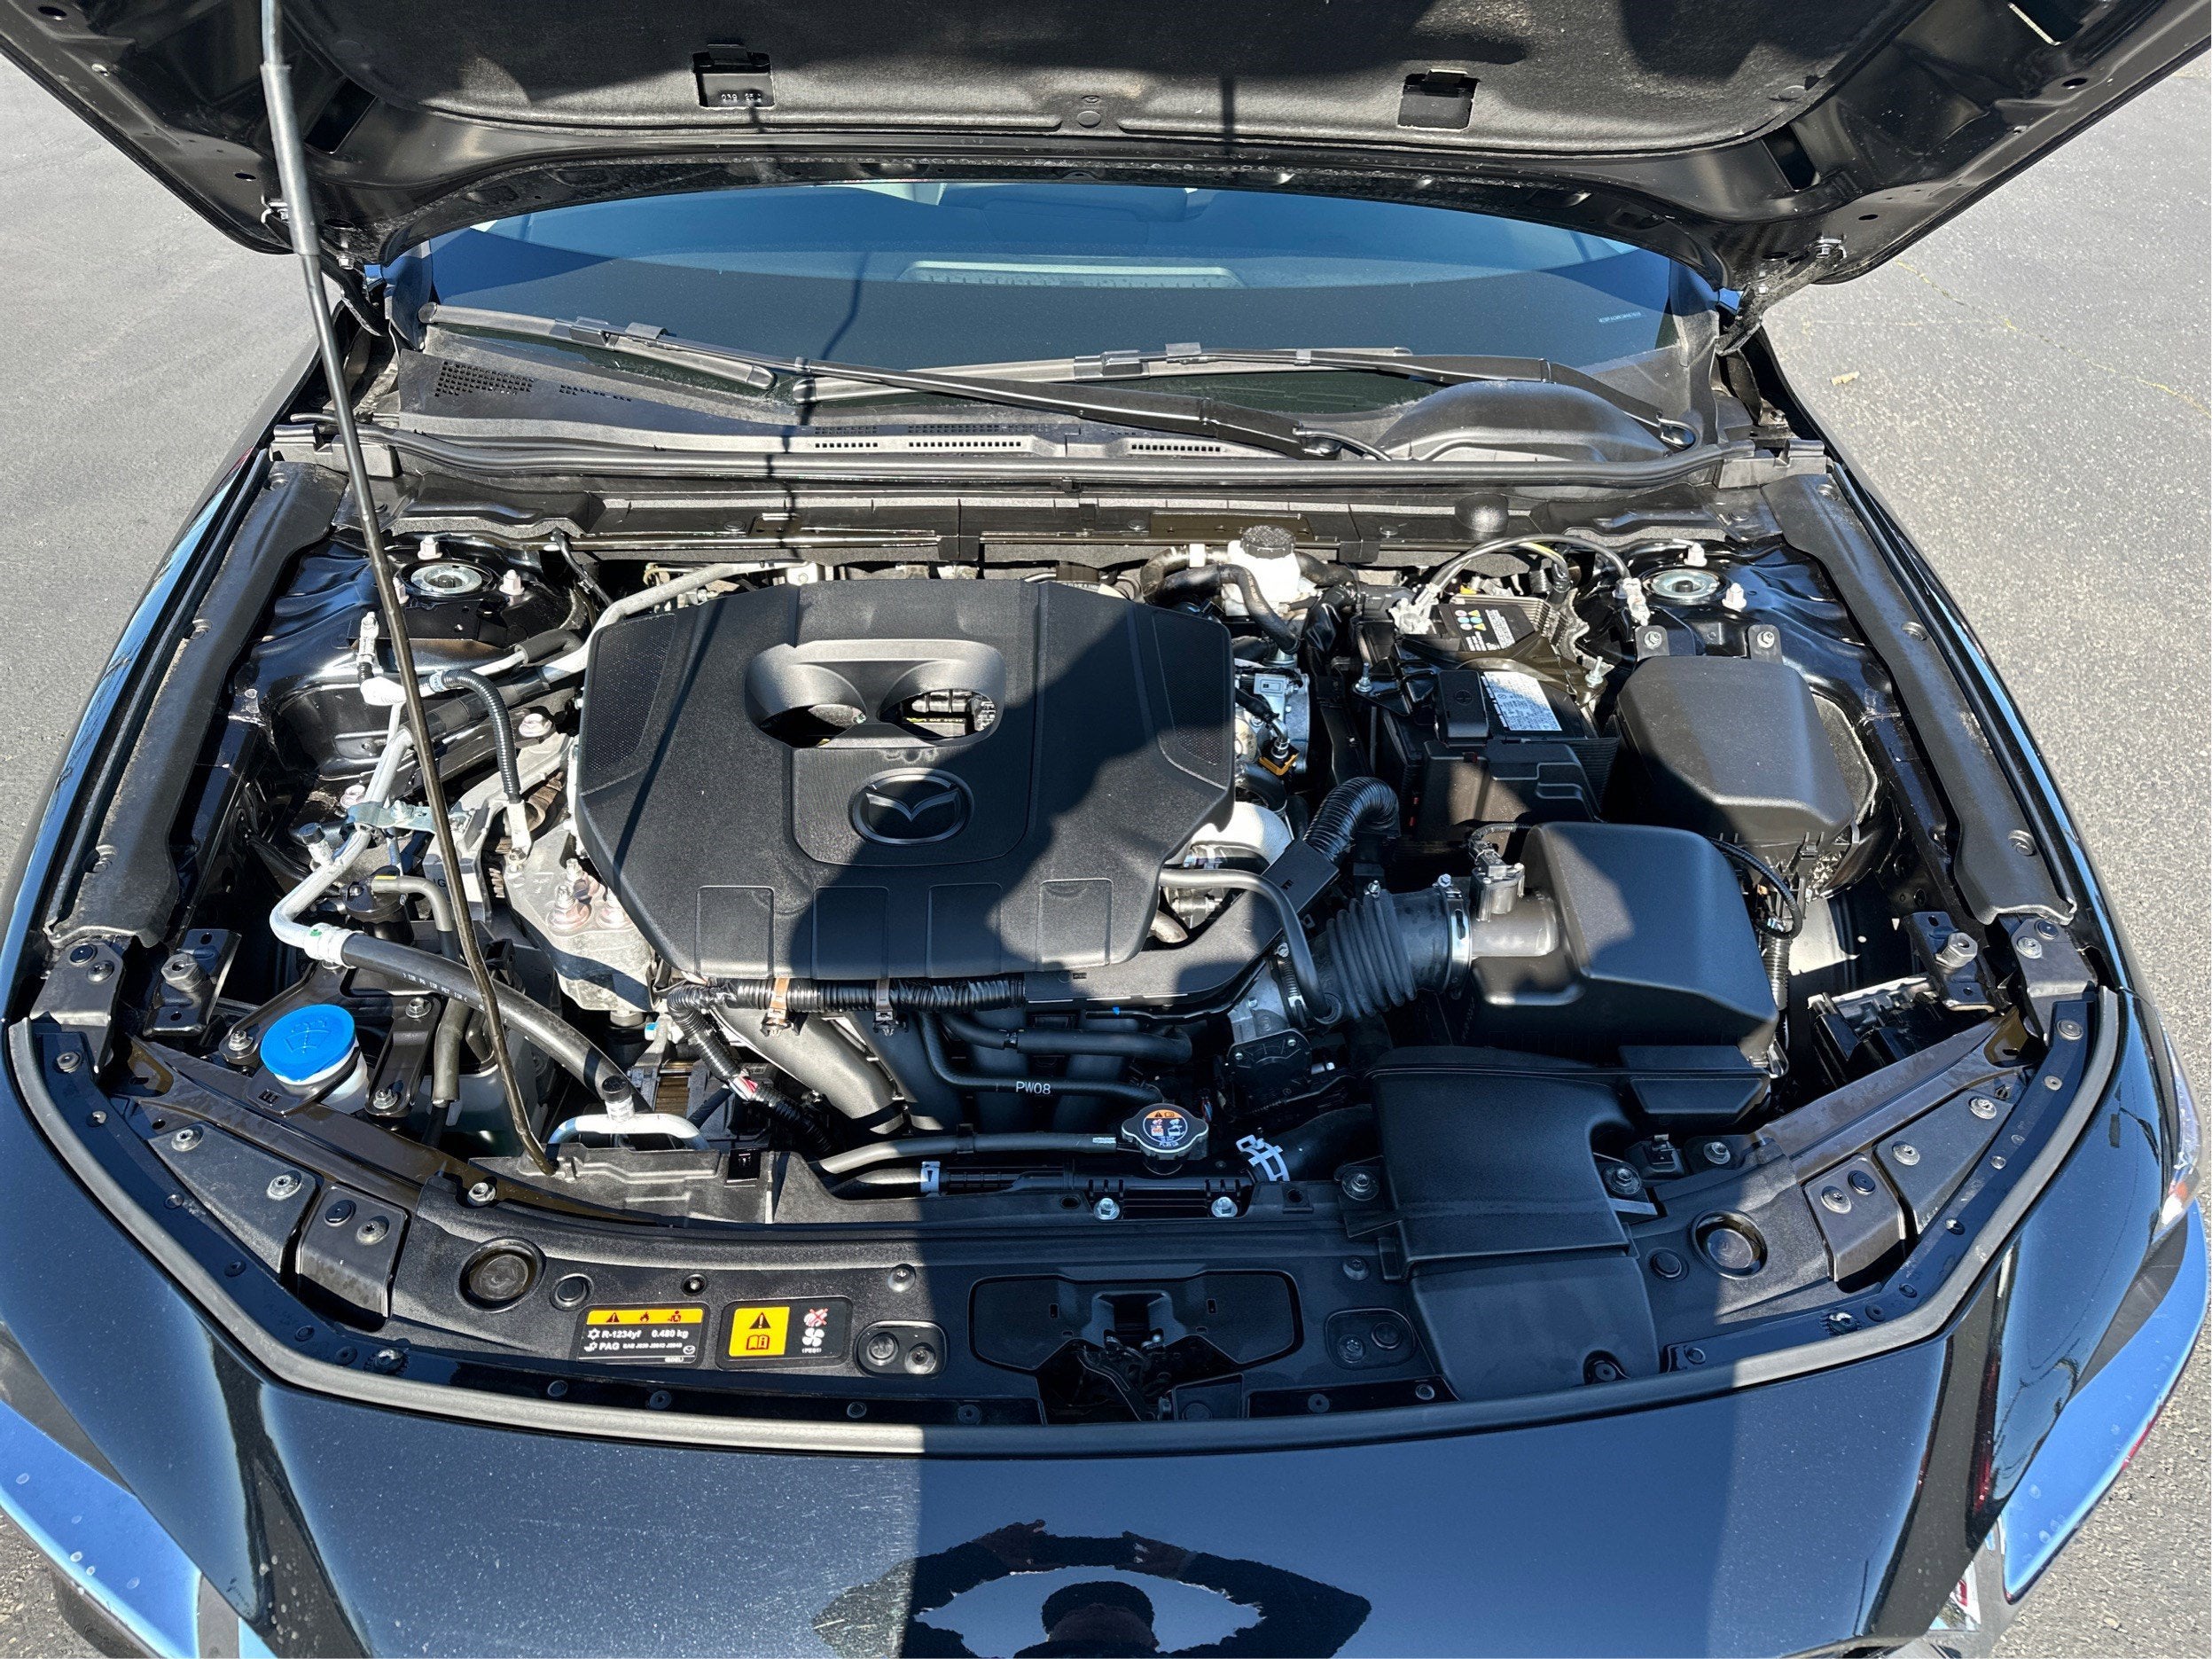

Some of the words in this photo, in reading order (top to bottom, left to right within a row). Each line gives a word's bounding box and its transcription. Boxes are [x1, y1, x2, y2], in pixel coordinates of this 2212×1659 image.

[1015, 1081, 1051, 1095] PW08
[601, 1329, 642, 1340] R-1234yf
[676, 1329, 689, 1339] kg
[598, 1342, 620, 1350] PAG
